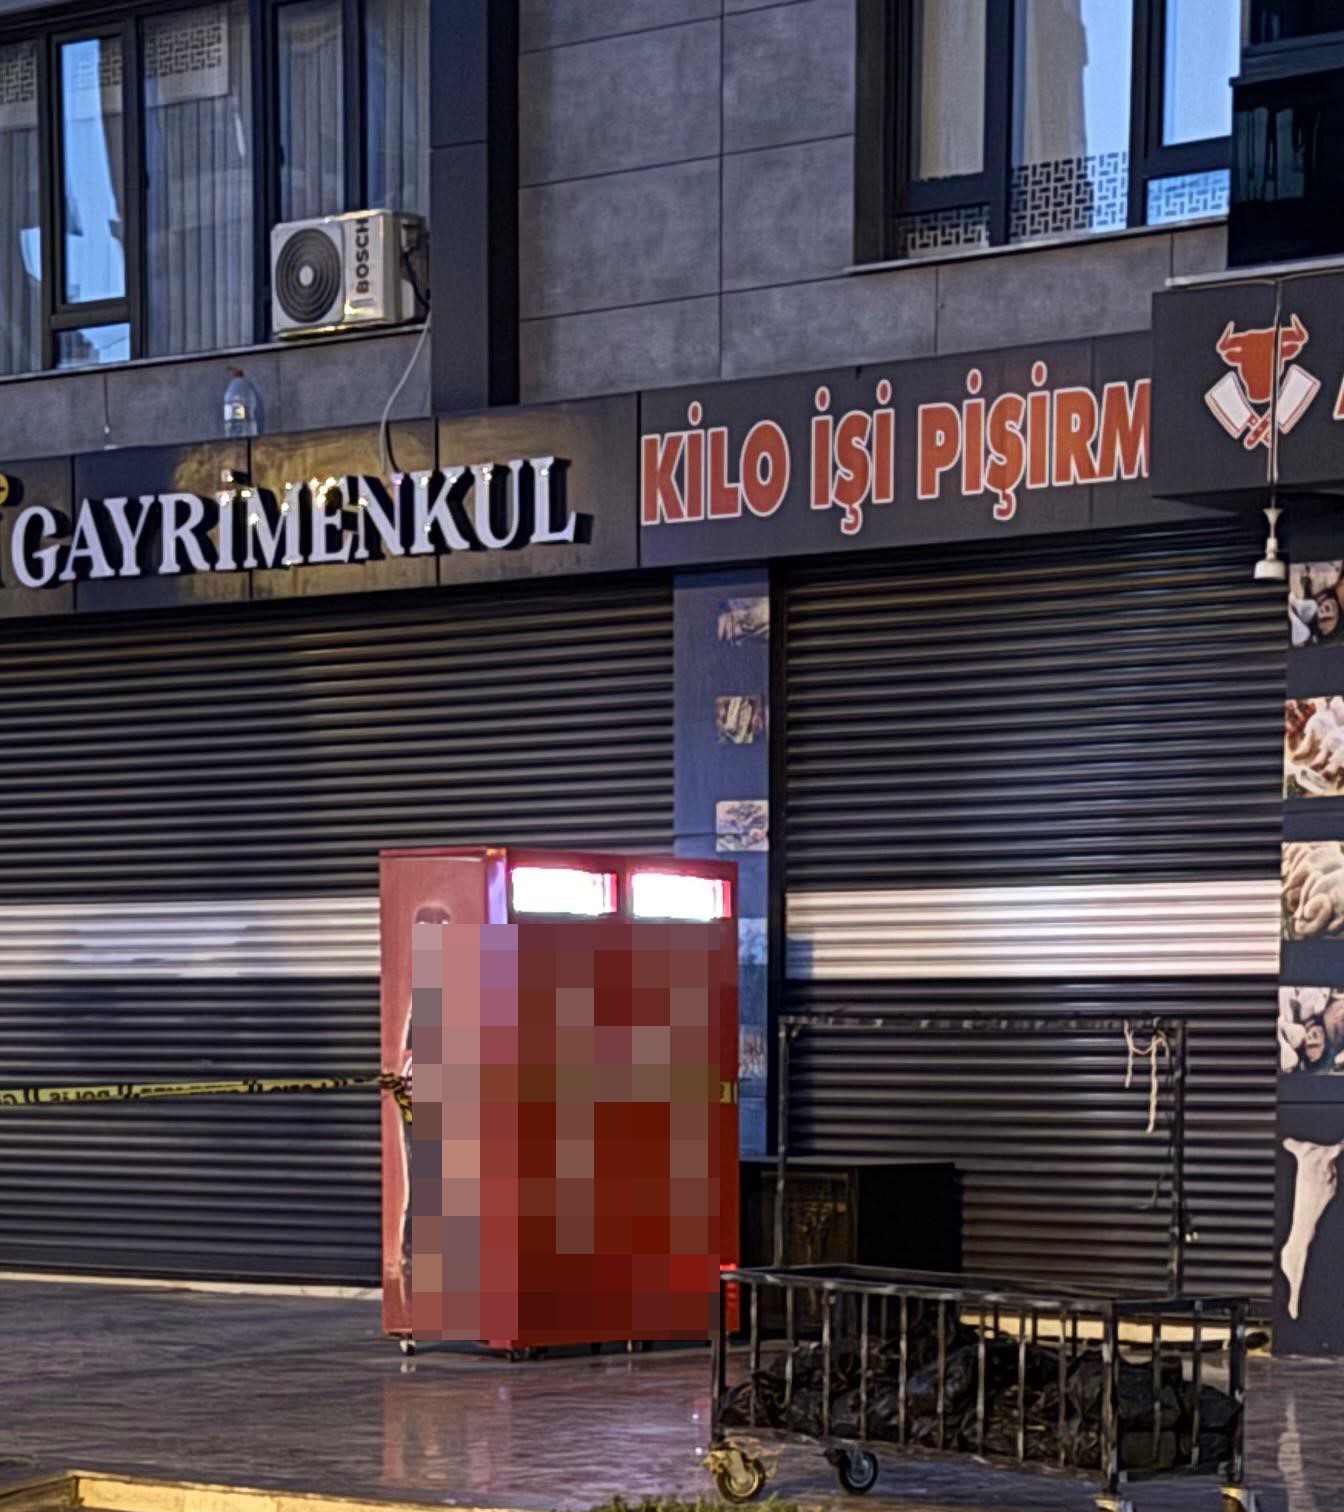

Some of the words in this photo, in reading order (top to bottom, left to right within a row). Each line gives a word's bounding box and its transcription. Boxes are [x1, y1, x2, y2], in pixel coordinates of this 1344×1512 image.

[355, 217, 370, 294] BOSCH
[641, 401, 790, 526] KİLO
[810, 379, 895, 535] İŞİ
[917, 360, 1152, 521] PİŞİRM
[11, 456, 576, 588] GAYRİMENKUL
